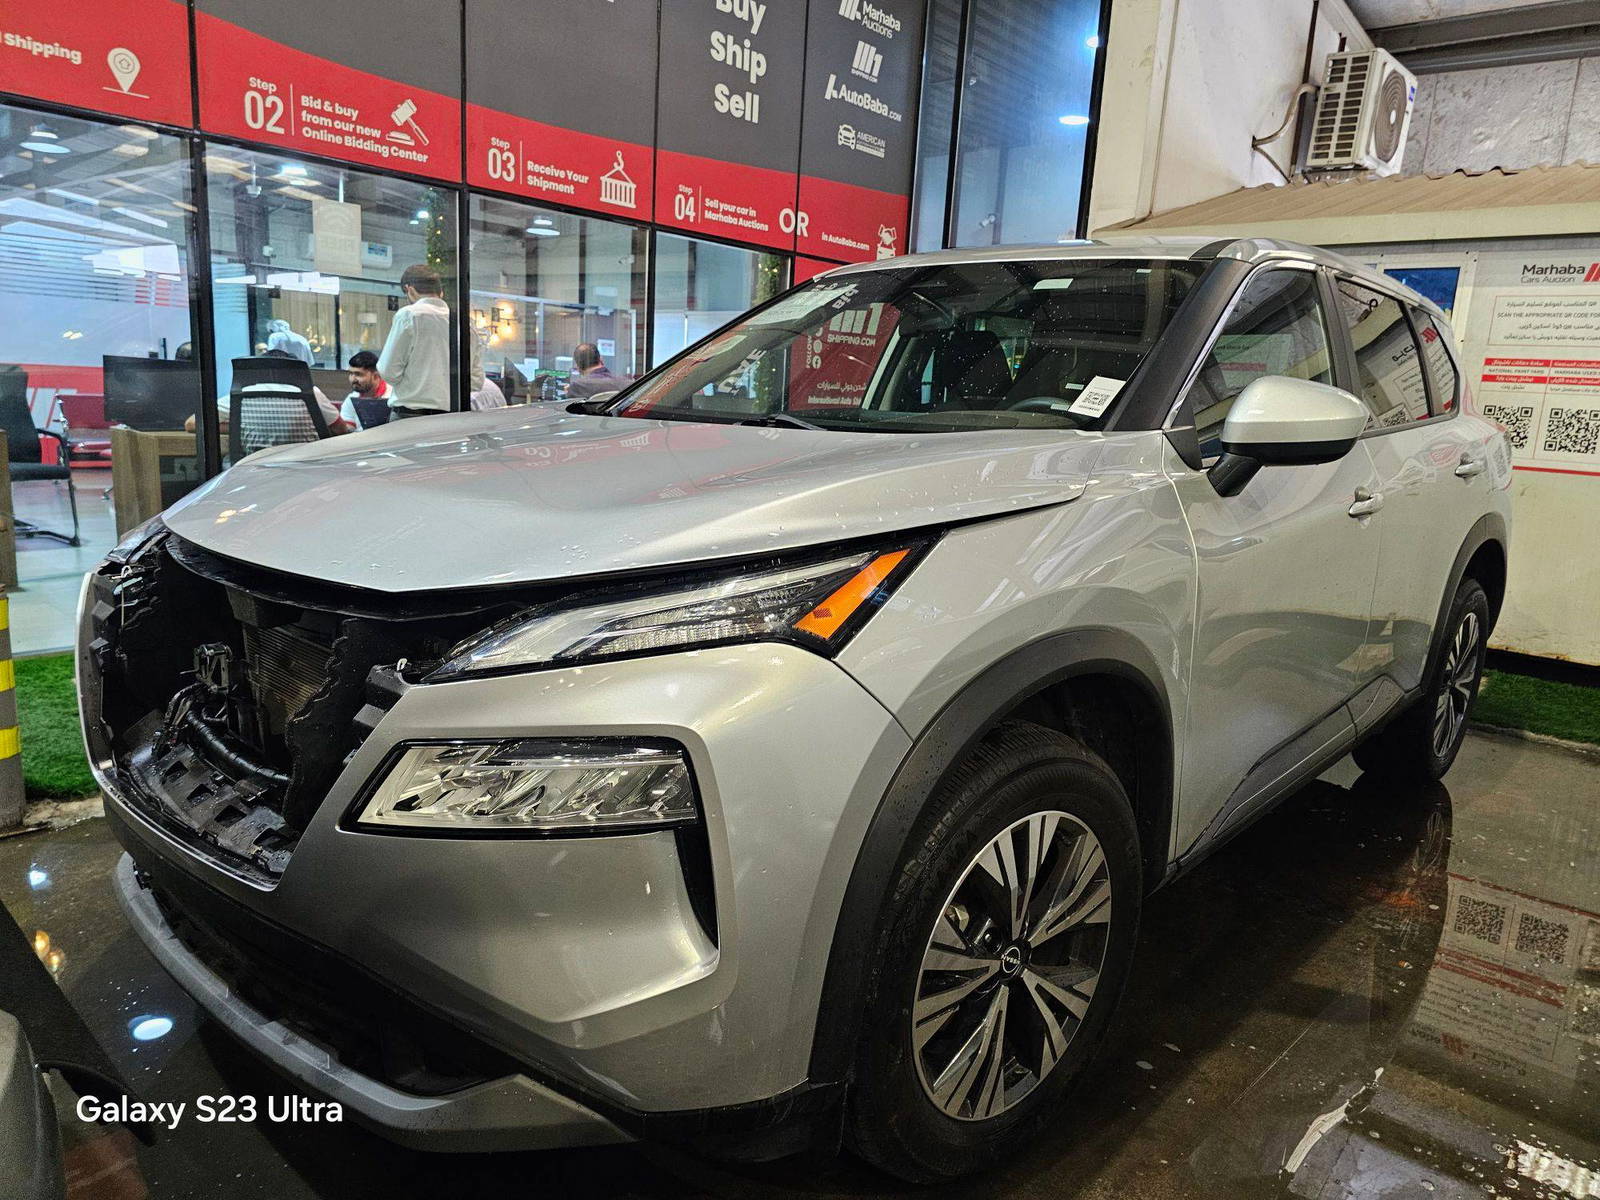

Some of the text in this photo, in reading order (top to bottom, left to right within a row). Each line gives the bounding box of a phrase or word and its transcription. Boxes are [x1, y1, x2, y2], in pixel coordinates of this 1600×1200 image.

[863, 1, 901, 32] Marhaba
[4, 32, 82, 65] shipping
[710, 31, 767, 84] Ship
[249, 77, 277, 94] Step
[244, 90, 285, 135] 02
[301, 95, 359, 121] Bid & buy
[714, 83, 759, 124] Sell
[301, 110, 381, 138] from our new
[302, 127, 429, 163] Online Bidding Center
[491, 136, 510, 150] Step
[857, 131, 886, 147] AMERICAN
[488, 148, 515, 182] 03
[527, 160, 589, 184] Receive Your
[527, 175, 575, 195] Shipment
[675, 194, 696, 223] 04
[705, 198, 757, 217] Sell your car in
[704, 209, 769, 232] Marhaba Auctions
[779, 208, 809, 237] OR
[821, 231, 829, 242] in
[1520, 276, 1575, 284] Cars Auction
[1521, 264, 1586, 275] Marhaba
[827, 333, 876, 347] SHIPPING.COM
